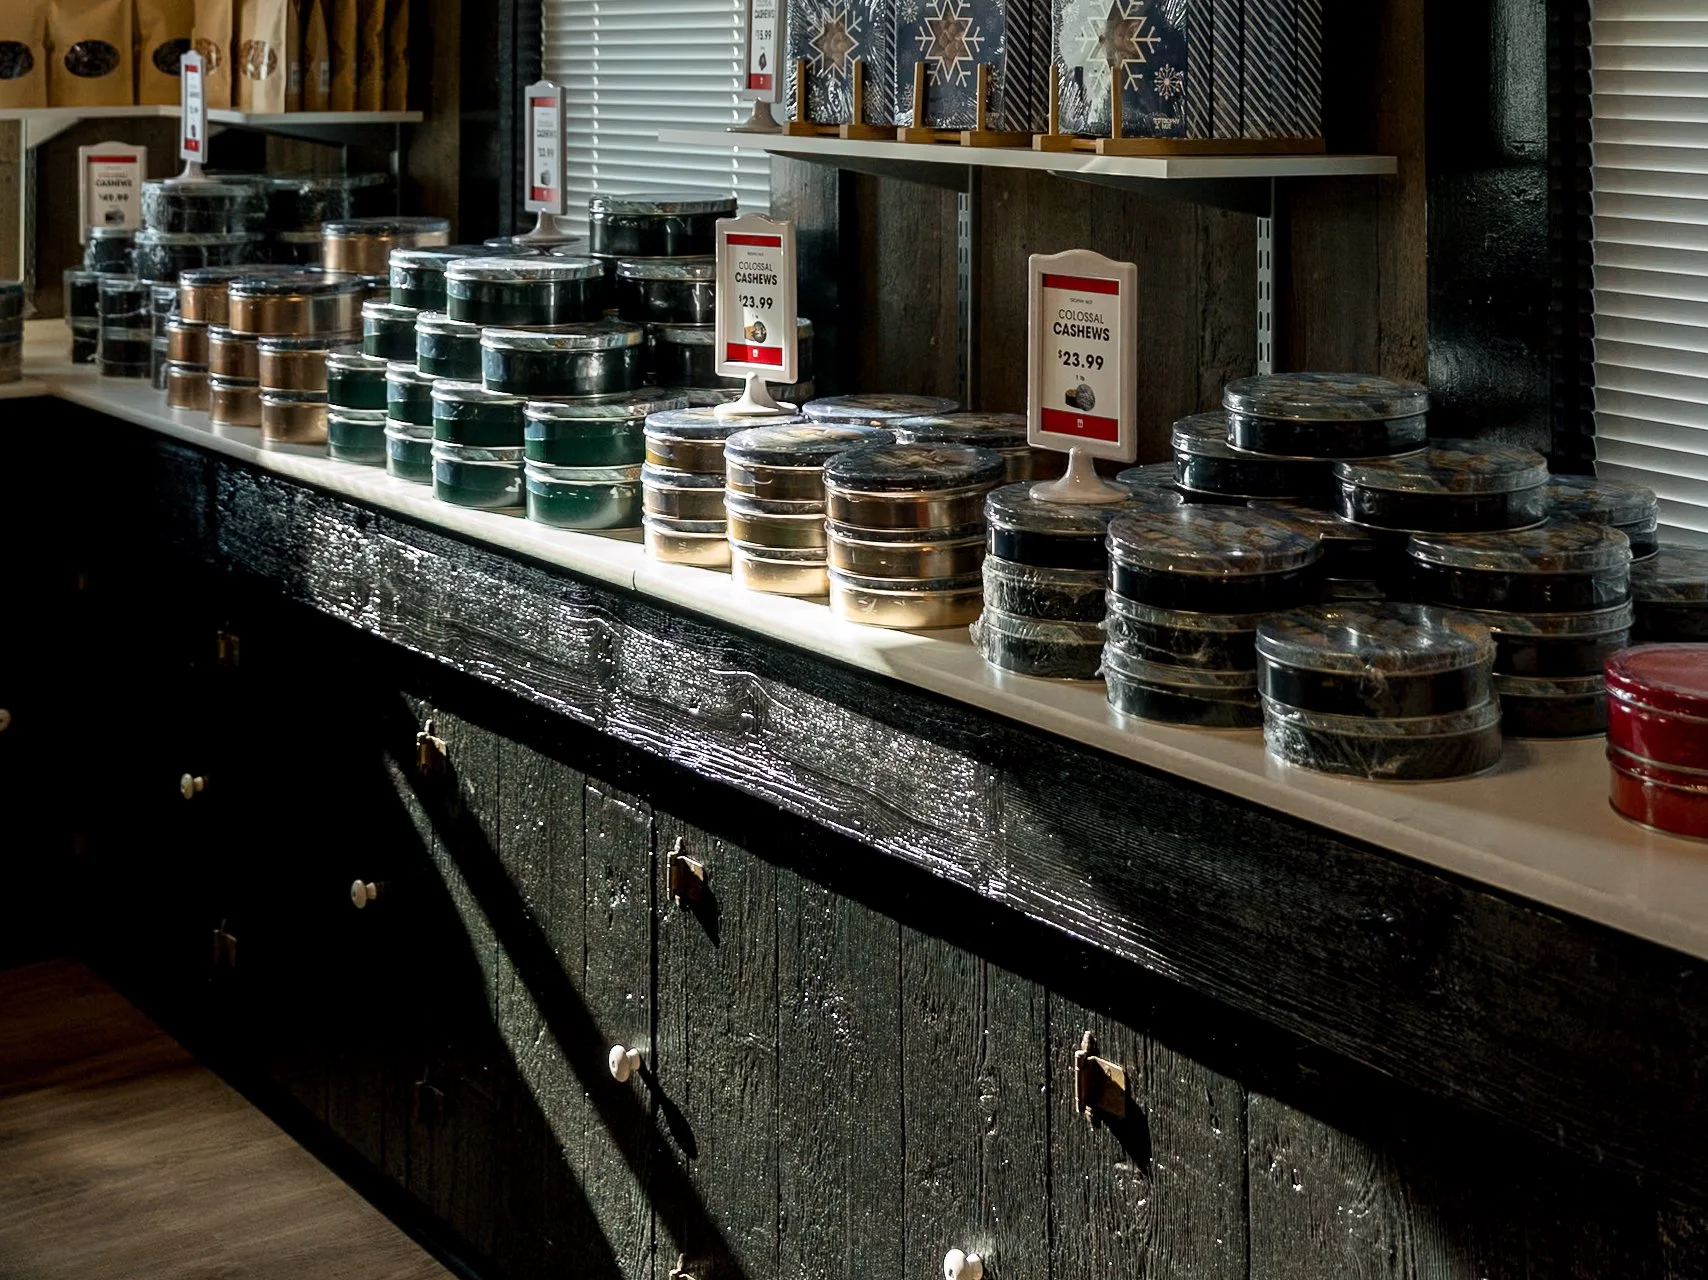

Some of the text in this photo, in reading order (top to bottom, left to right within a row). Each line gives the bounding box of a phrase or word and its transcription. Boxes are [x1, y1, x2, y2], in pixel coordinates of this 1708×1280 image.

[754, 9, 775, 19] CASHEWS
[96, 179, 133, 187] CASHEWS
[738, 261, 773, 272] COLOSSAL
[735, 272, 778, 286] CASHEWS
[738, 294, 773, 309] $23.99
[1058, 308, 1104, 324] COLOSSAL
[1053, 321, 1110, 341] CASHEWS
[1057, 349, 1104, 370] $23.99
